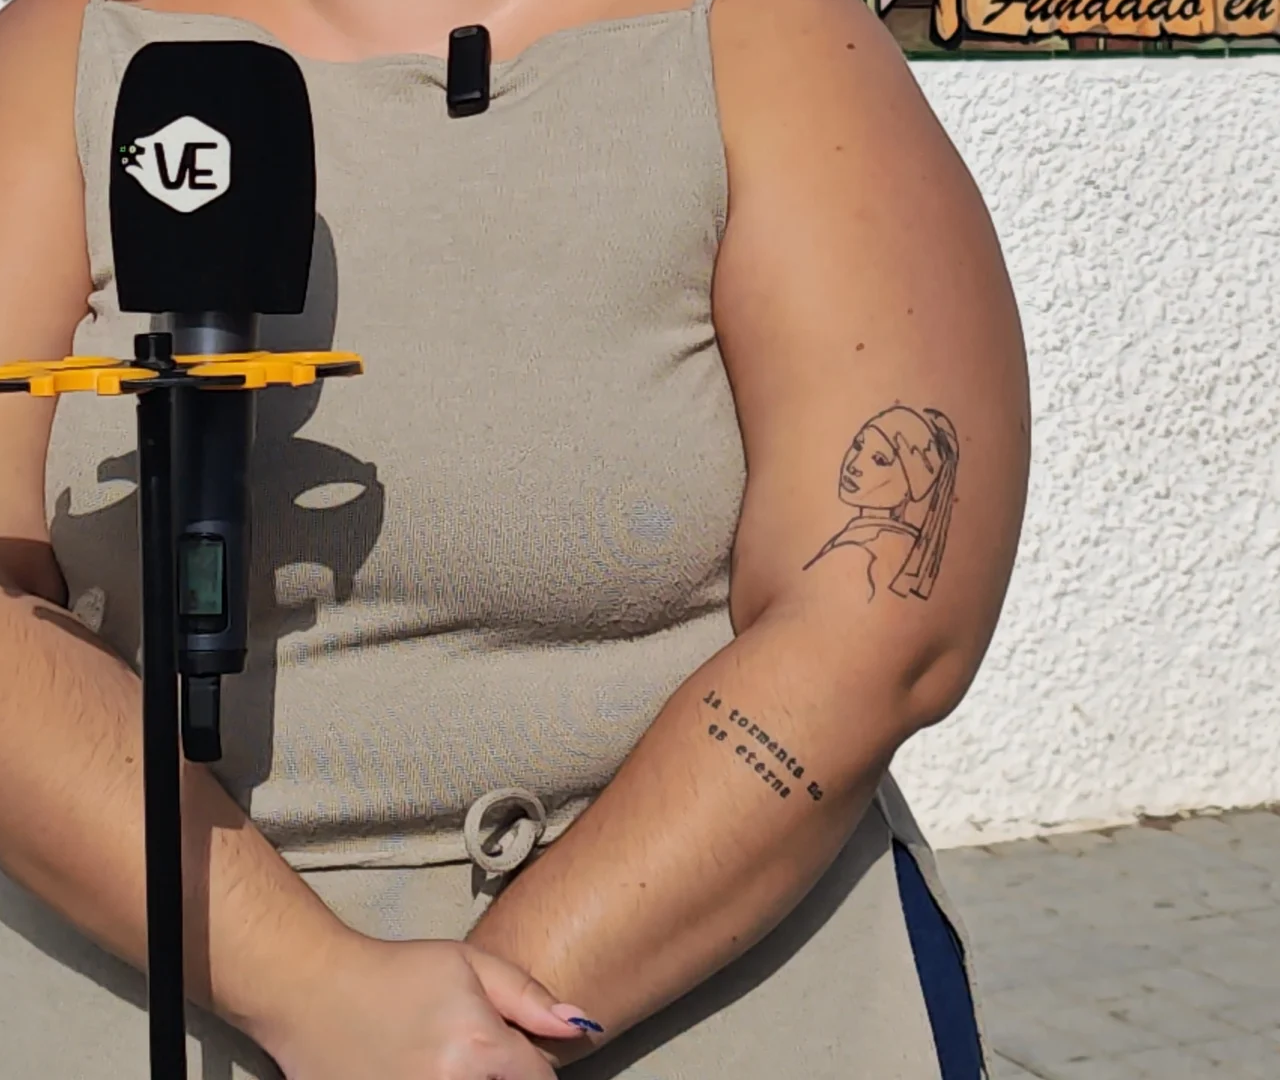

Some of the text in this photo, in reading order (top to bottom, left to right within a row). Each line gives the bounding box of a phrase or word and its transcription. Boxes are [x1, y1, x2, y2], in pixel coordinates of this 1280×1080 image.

[153, 142, 218, 191] VE
[728, 708, 805, 780] tormenta
[735, 744, 792, 799] eterna
